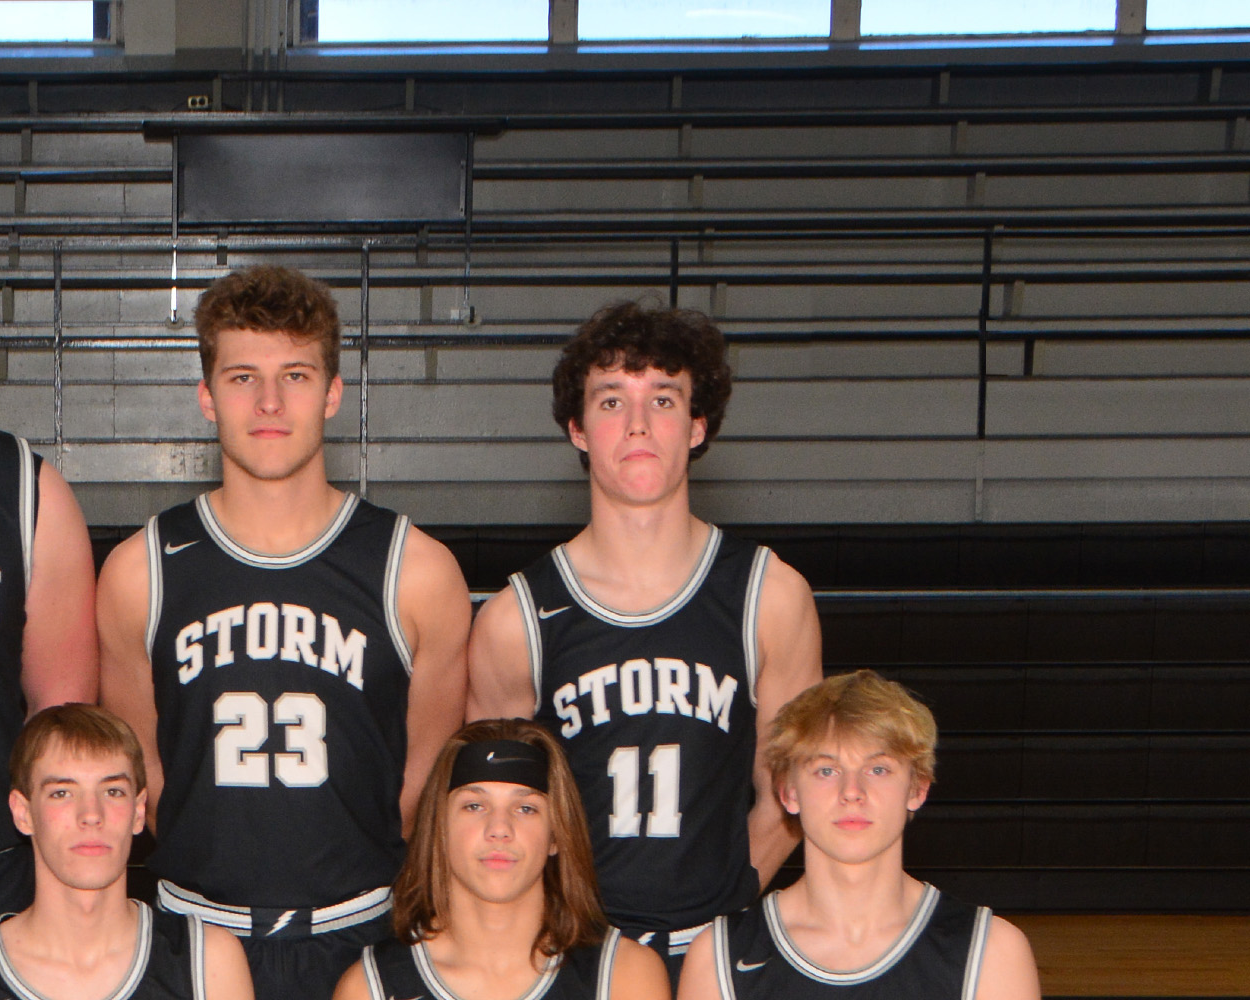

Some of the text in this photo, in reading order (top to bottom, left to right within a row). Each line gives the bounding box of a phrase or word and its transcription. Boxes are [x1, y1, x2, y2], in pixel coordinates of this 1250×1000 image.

[175, 604, 367, 691] STORM
[213, 693, 329, 788] 23
[553, 657, 738, 738] STORM
[607, 744, 682, 839] 11
